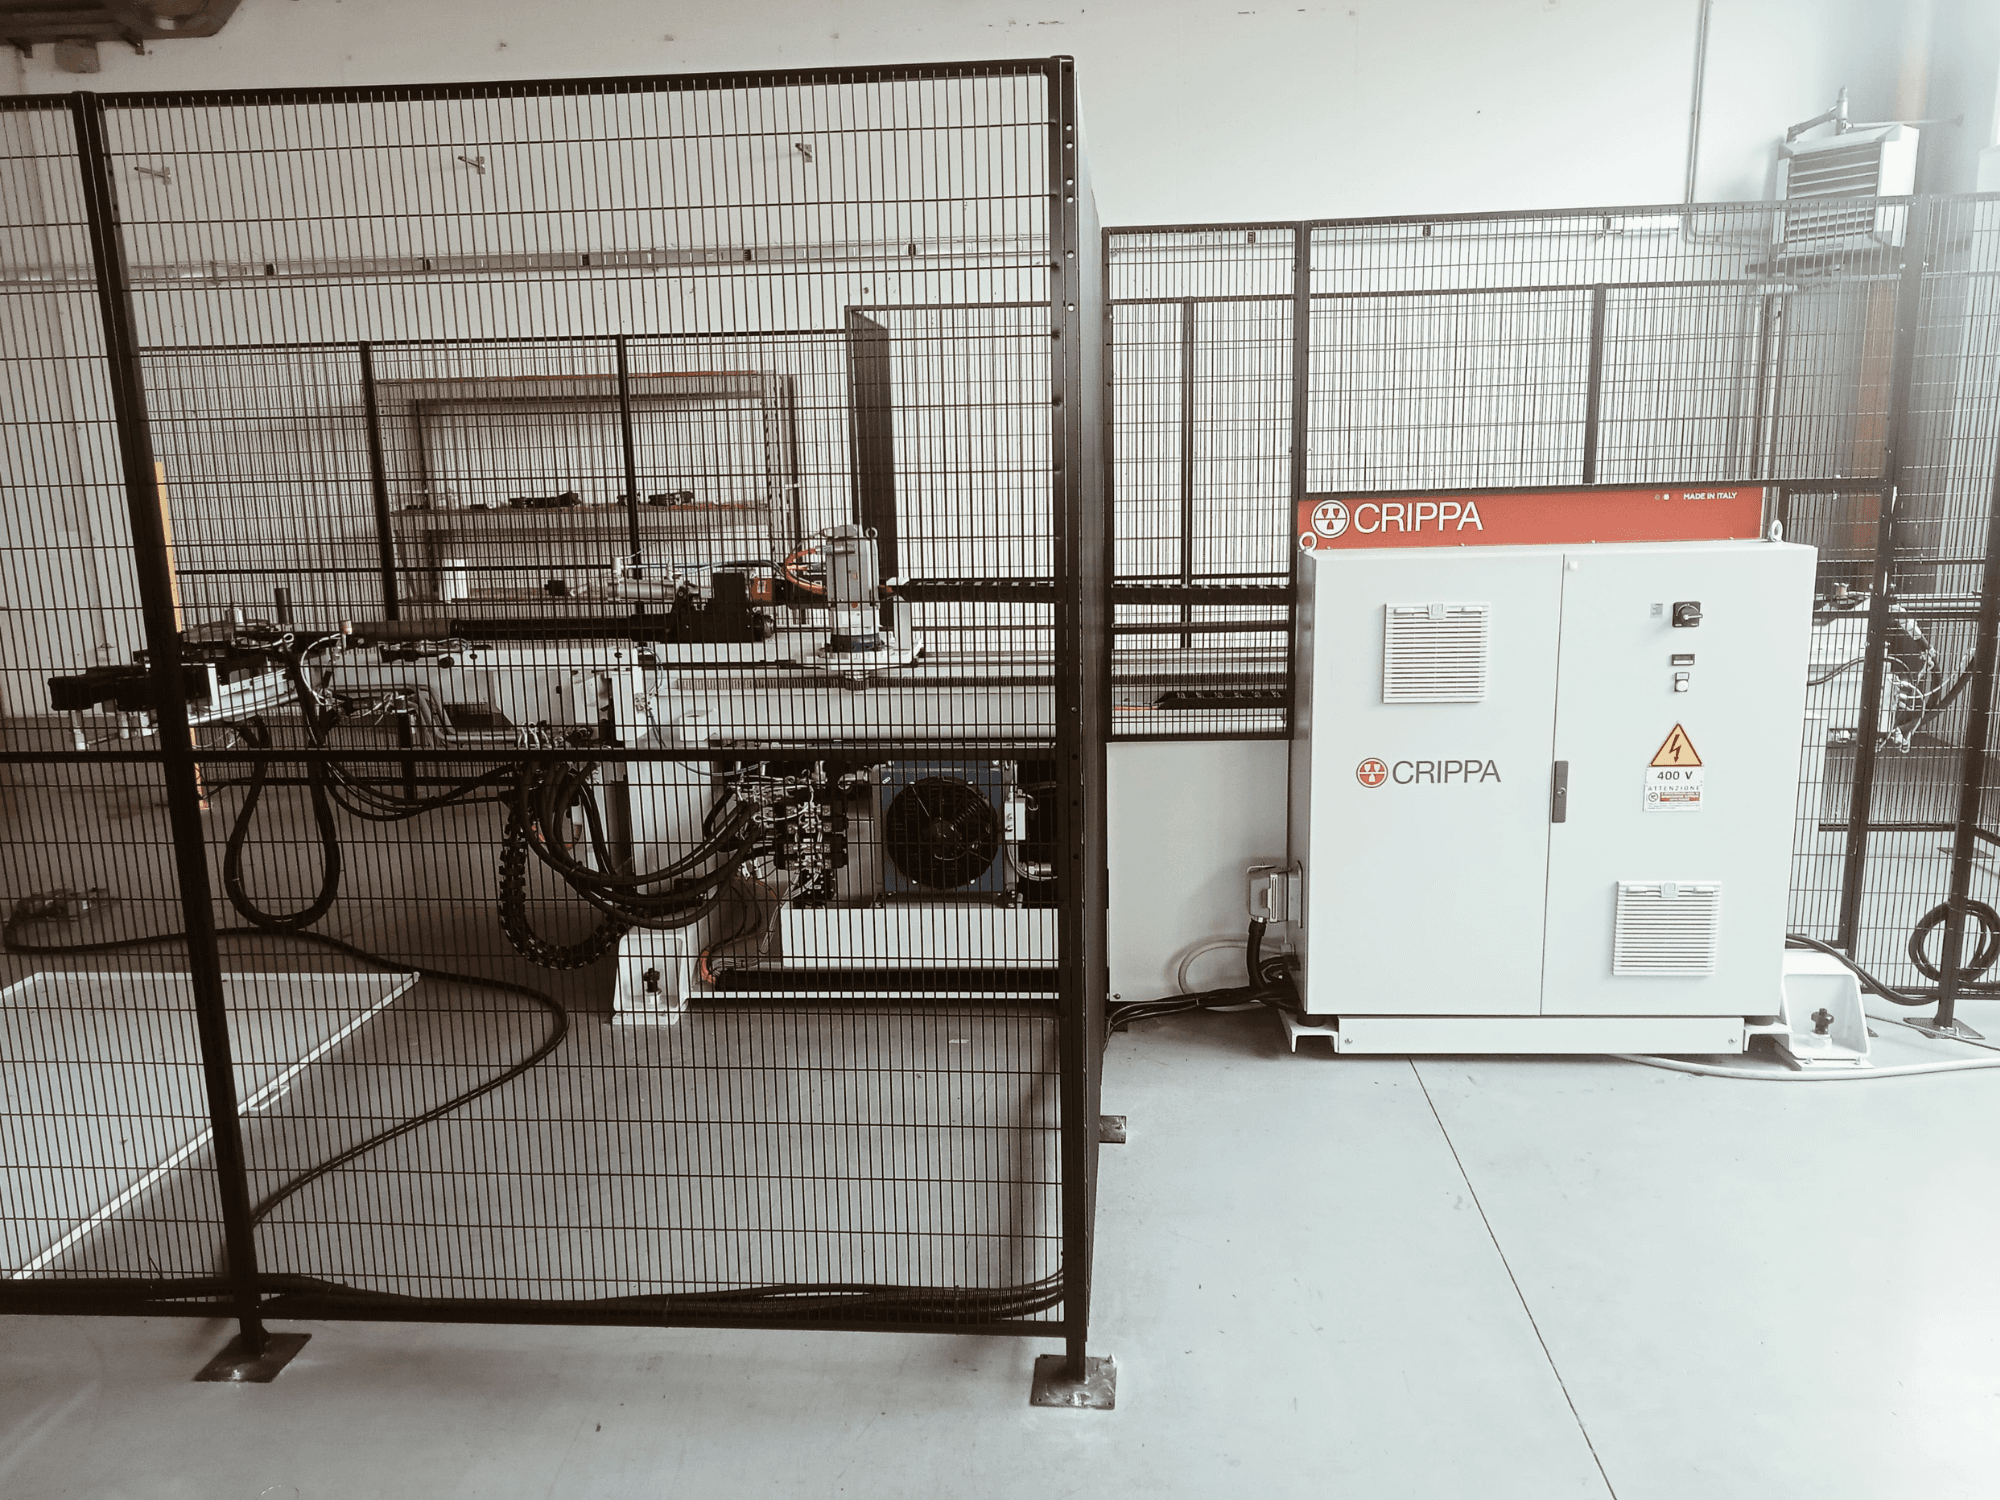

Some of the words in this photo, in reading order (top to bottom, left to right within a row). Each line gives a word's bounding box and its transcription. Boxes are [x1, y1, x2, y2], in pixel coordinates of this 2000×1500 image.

[1354, 501, 1483, 533] CRIPPA
[1392, 759, 1502, 785] CRIPPA
[1657, 771, 1680, 780] 400
[1685, 771, 1693, 779] V
